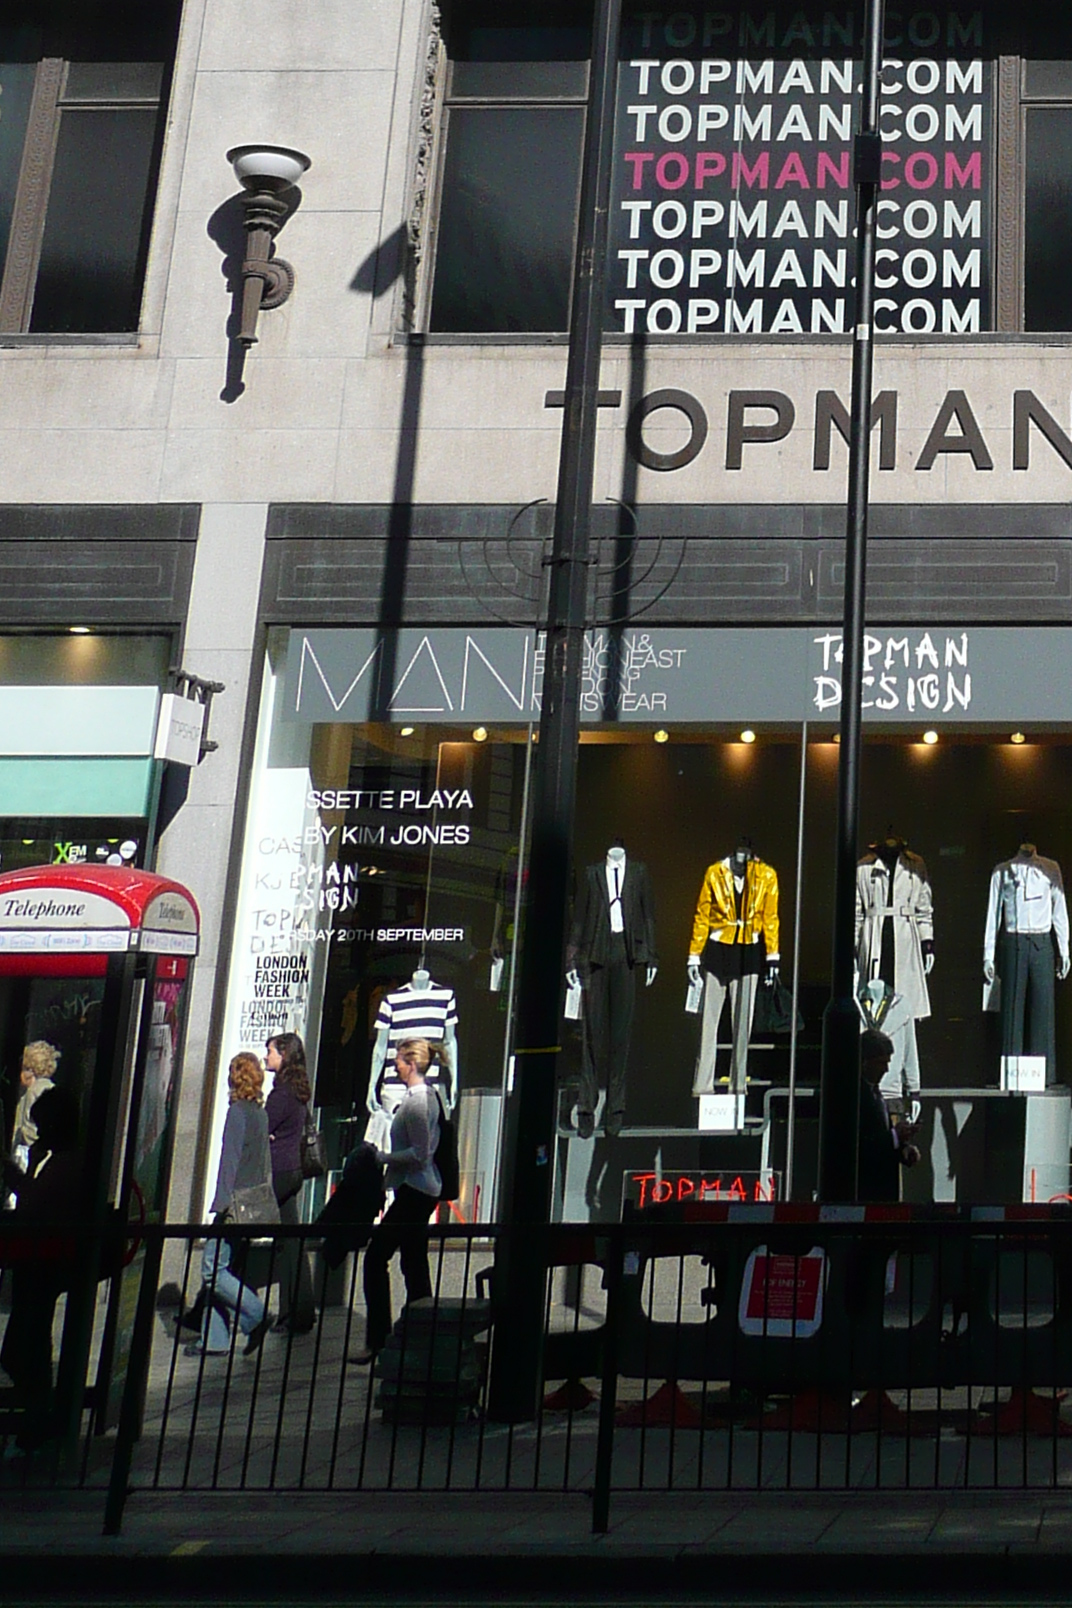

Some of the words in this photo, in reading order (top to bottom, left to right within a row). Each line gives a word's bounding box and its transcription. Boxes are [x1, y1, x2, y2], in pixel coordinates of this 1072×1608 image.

[626, 103, 982, 142] TOPMANCOM
[623, 151, 981, 190] TOPMANCOM
[620, 199, 981, 240] TOPMAN.COM
[616, 248, 980, 289] TOPMAN.COM
[614, 298, 979, 332] TOPMANCOM
[295, 635, 529, 712] MAN
[400, 789, 473, 810] PLAYA
[342, 826, 385, 845] KIM
[390, 824, 470, 845] JONES
[4, 899, 86, 920] Telephone
[376, 928, 464, 942] SEPTEMBER
[256, 955, 308, 969] LONDON
[254, 969, 309, 984] FASHION
[254, 983, 290, 998] WEEK
[632, 1172, 775, 1209] TOPMAN
